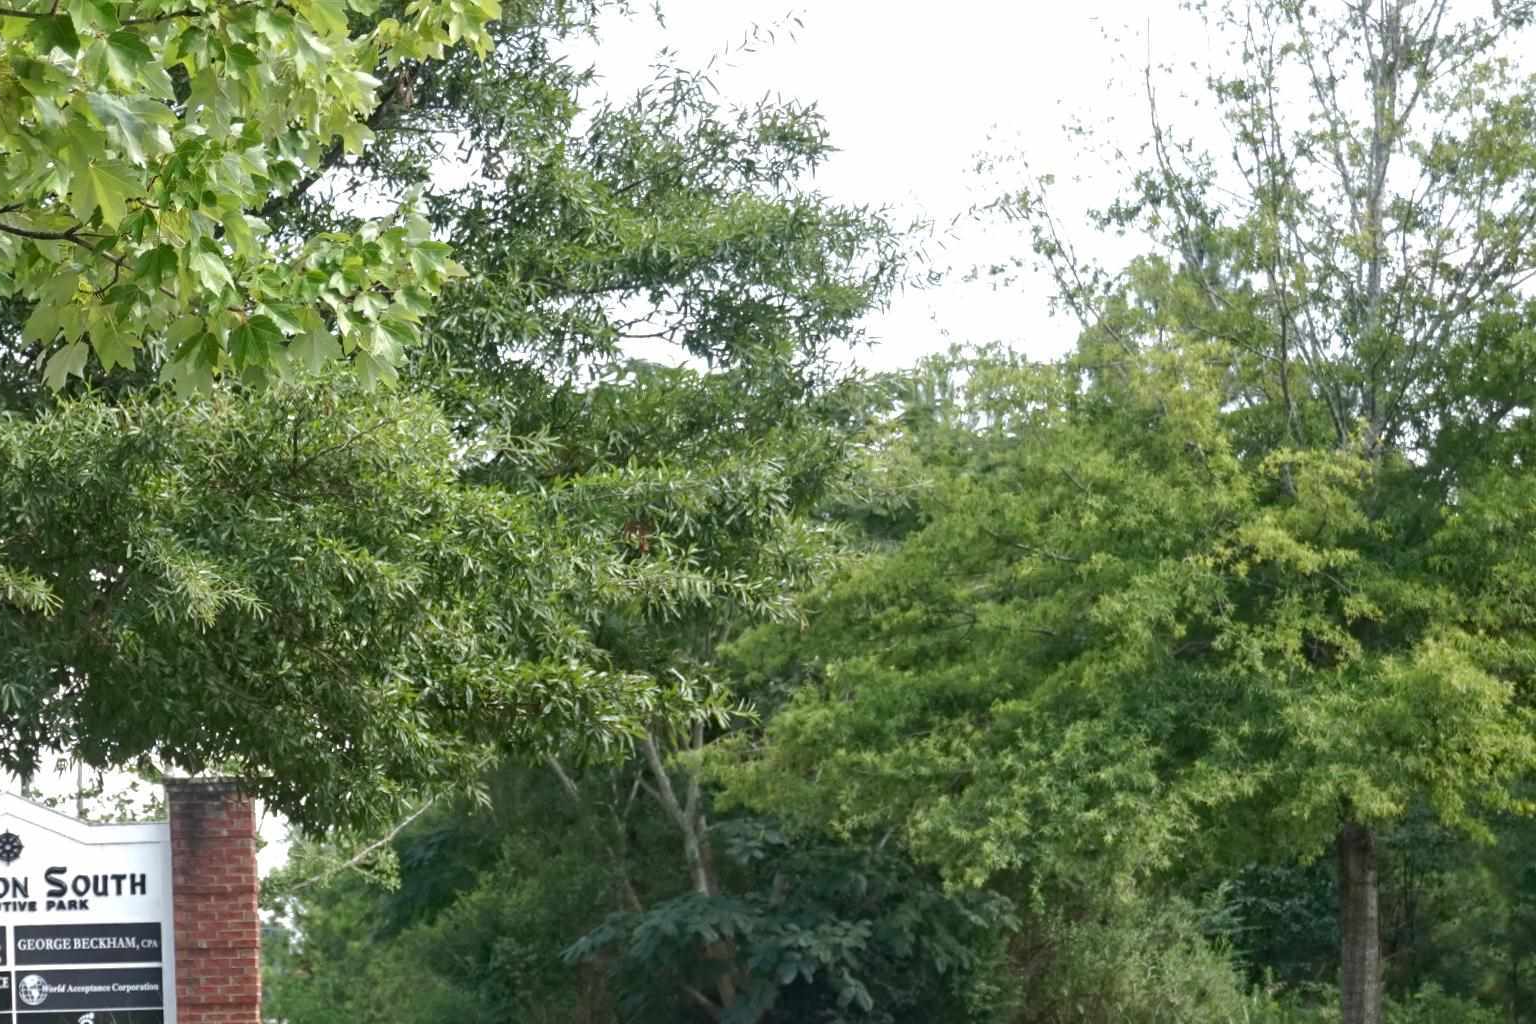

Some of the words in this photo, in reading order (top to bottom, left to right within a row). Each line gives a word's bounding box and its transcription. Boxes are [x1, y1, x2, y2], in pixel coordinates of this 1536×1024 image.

[46, 899, 89, 911] PARK
[17, 938, 71, 951] GEORGE
[73, 936, 140, 951] BECKHAM,
[141, 939, 159, 949] CPA
[42, 983, 65, 993] World
[66, 982, 111, 994] Acceptance
[111, 982, 159, 993] Corporation
